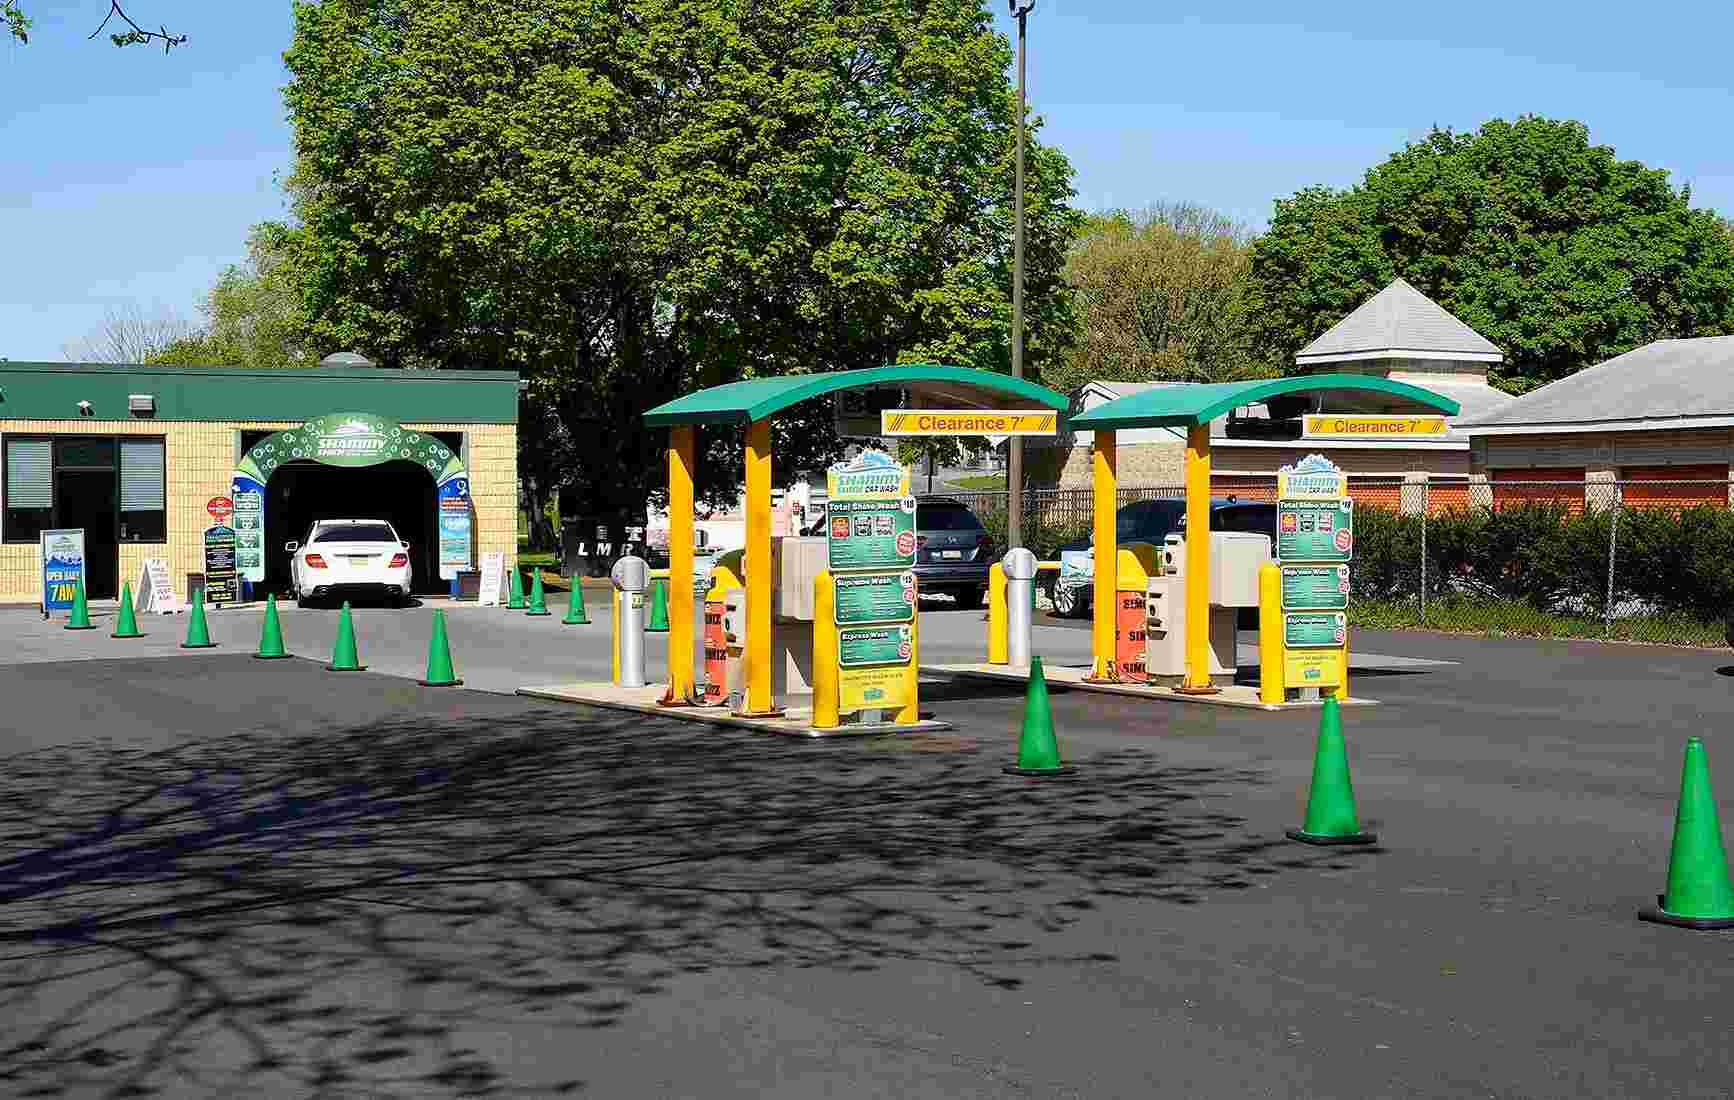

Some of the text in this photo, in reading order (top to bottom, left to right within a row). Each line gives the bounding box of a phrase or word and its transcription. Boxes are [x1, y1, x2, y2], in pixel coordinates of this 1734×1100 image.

[918, 416, 1025, 431] Clearance 7'
[1334, 418, 1422, 433] Clearance 7'
[829, 503, 848, 512] Total
